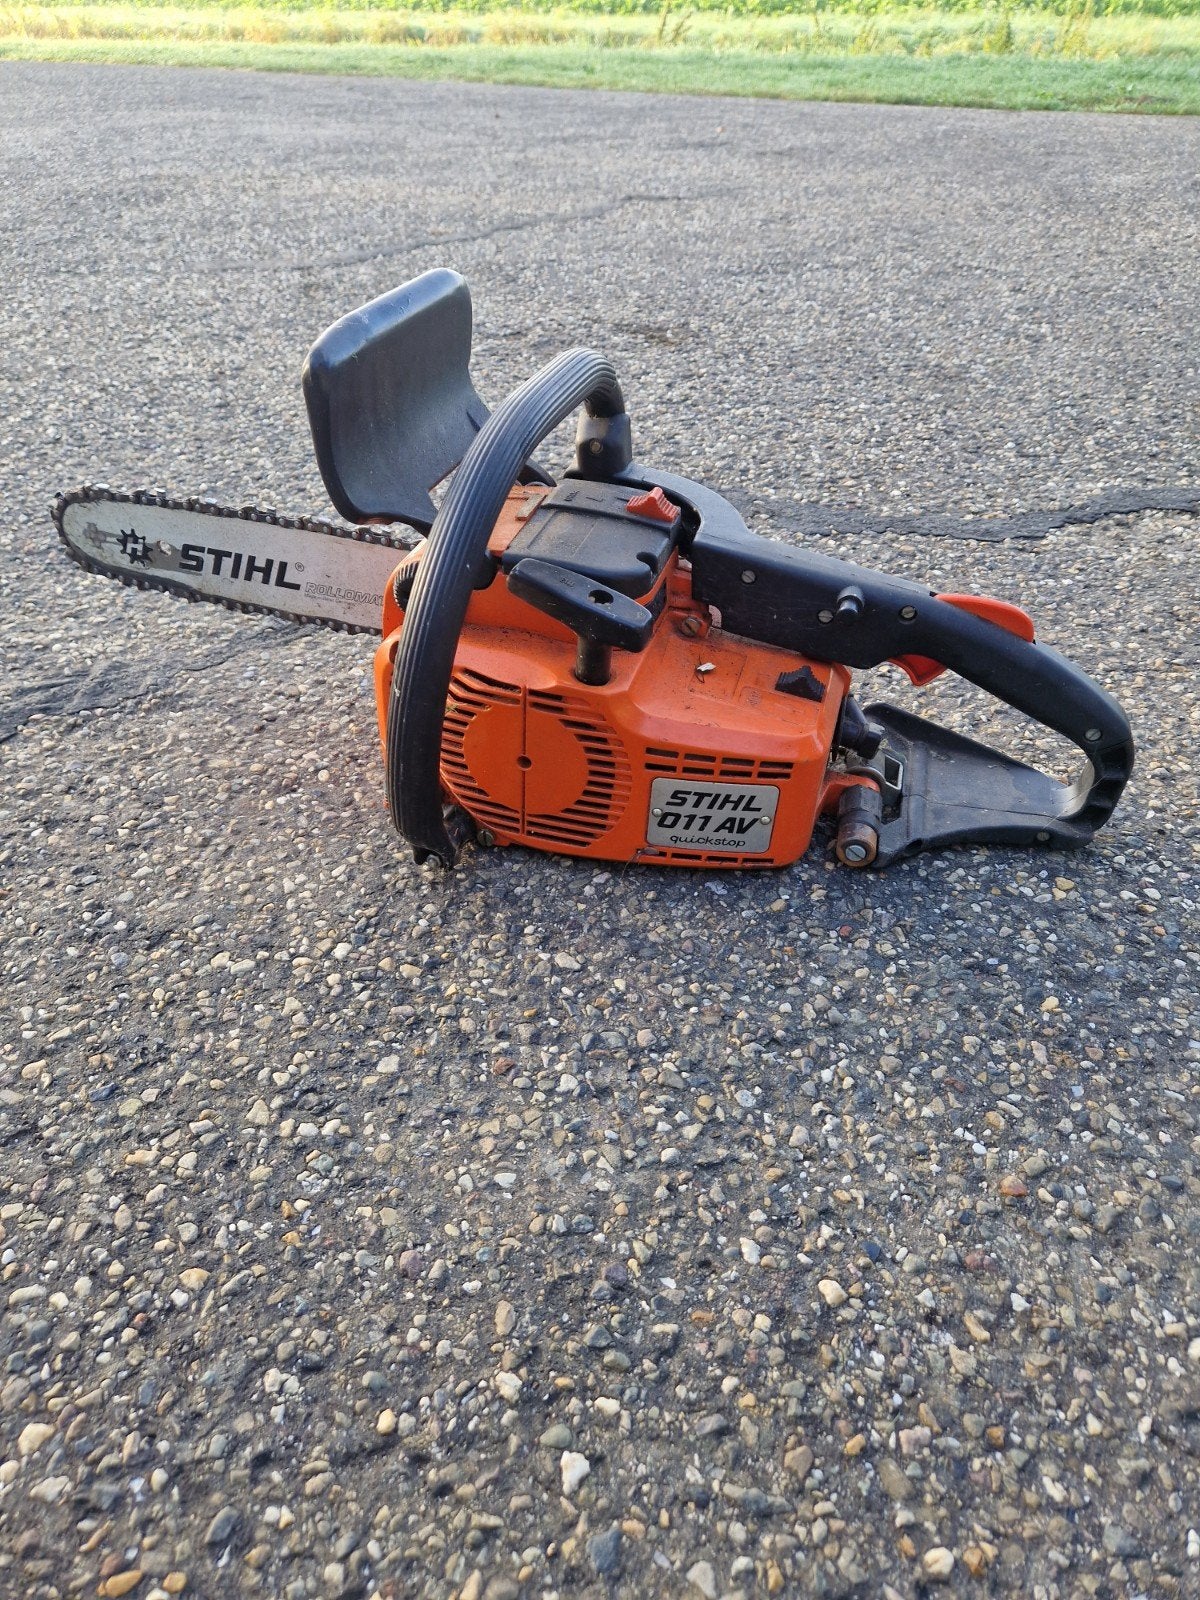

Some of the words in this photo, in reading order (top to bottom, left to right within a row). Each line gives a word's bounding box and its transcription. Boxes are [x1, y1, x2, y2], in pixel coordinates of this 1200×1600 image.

[665, 790, 763, 812] STIHL
[657, 812, 712, 832] 011
[713, 816, 760, 835] AV
[670, 835, 746, 848] quickstop
